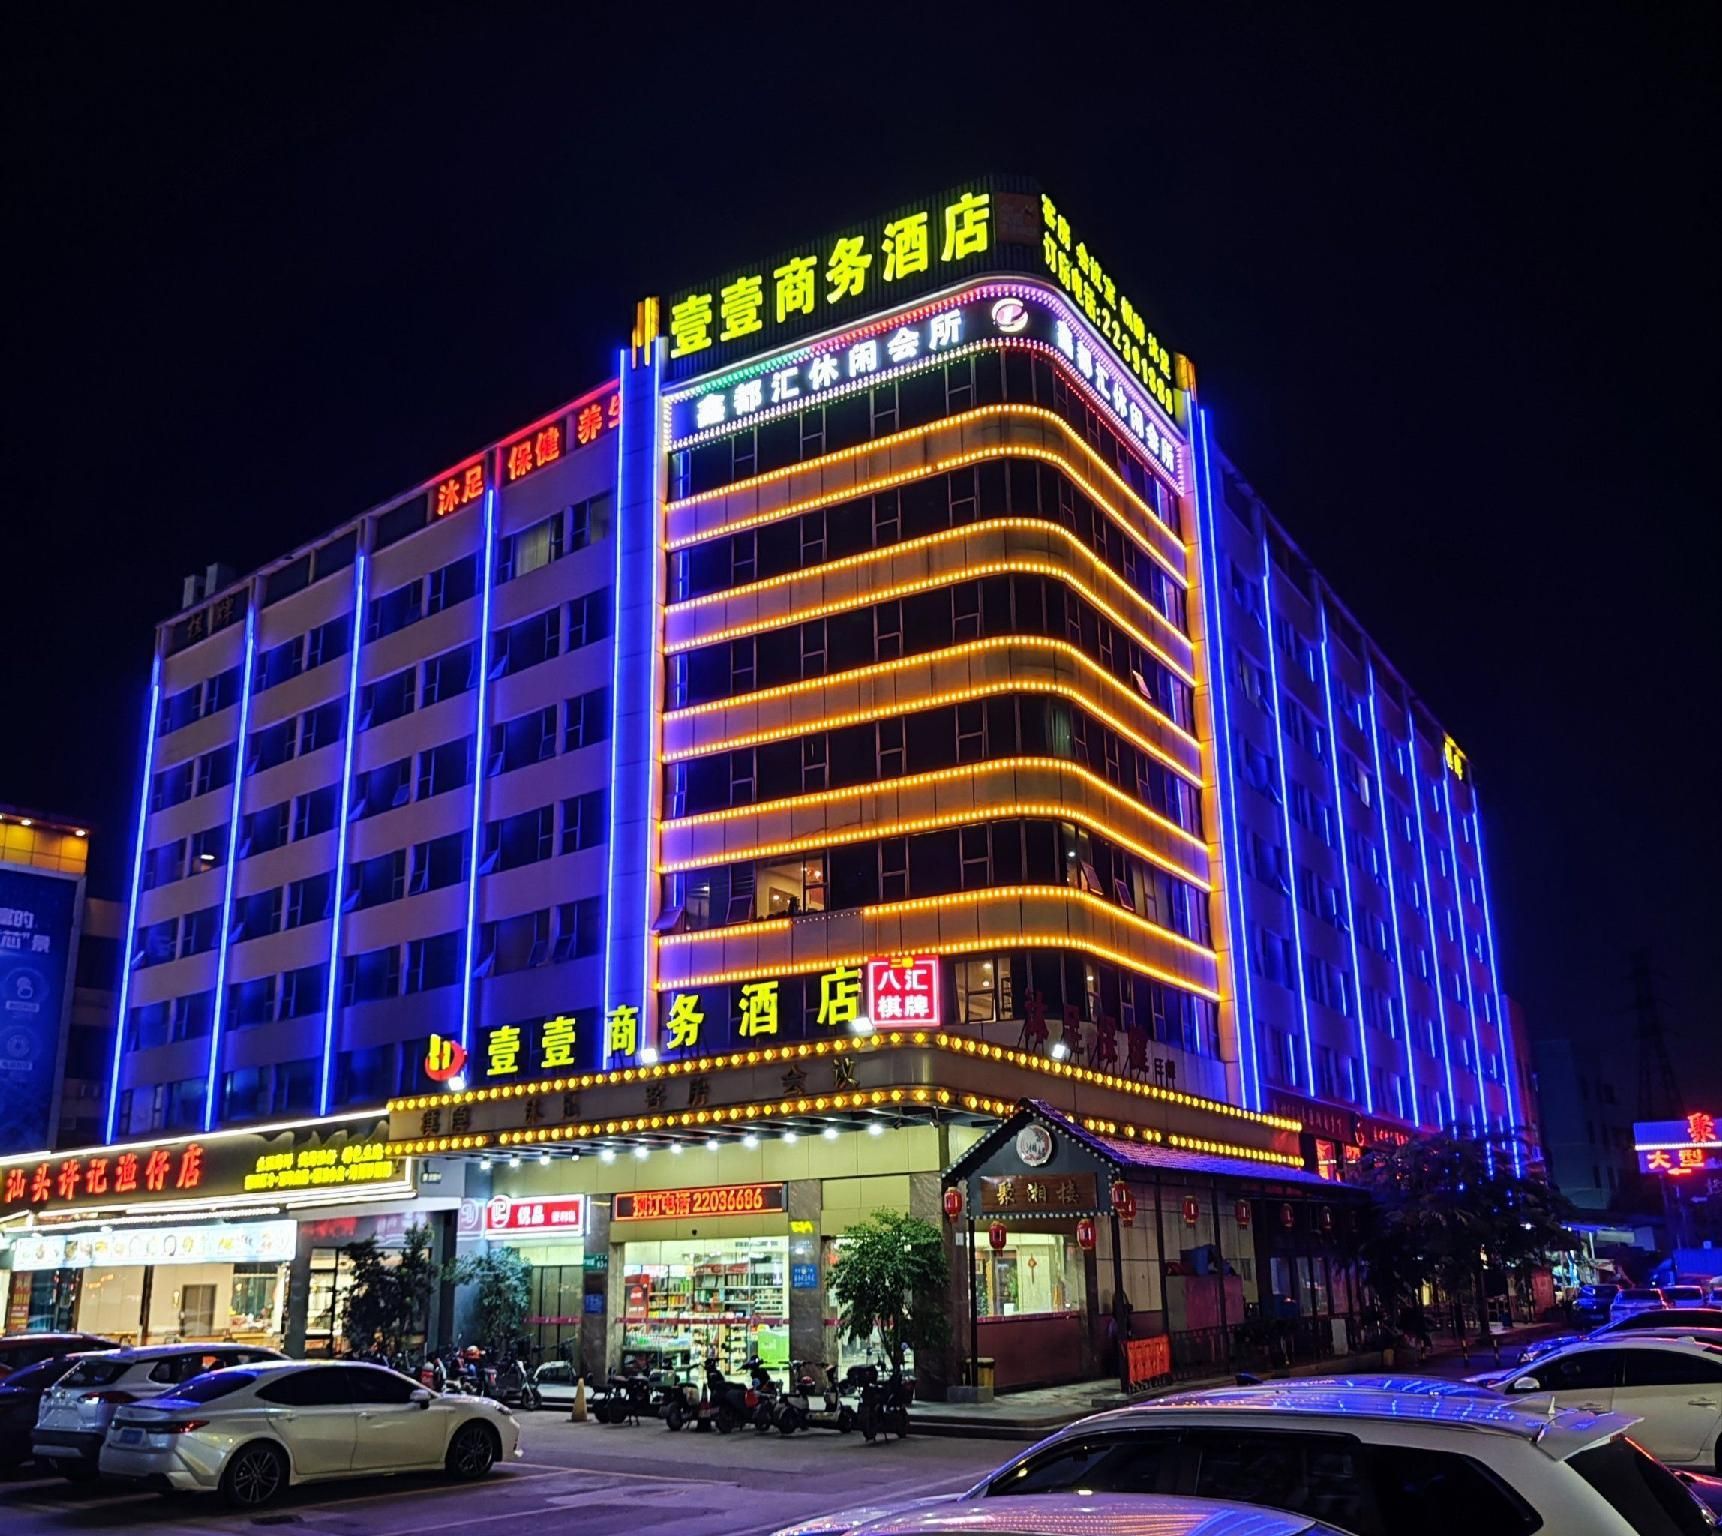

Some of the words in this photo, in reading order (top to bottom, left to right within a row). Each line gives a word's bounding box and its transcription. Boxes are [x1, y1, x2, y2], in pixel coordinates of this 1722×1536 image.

[671, 193, 991, 358] 壹壹商务酒店
[1057, 320, 1173, 471] 汇休闲会所
[438, 465, 484, 515] 沐足
[508, 427, 559, 480] 保健
[877, 967, 928, 990] 八汇
[877, 994, 930, 1018] 棋牌
[486, 966, 864, 1076] 壹壹商务酒店
[4, 1142, 204, 1203] 汕头许记渔仔店
[633, 1190, 690, 1217] 预订电话
[693, 1188, 763, 1212] 22036686
